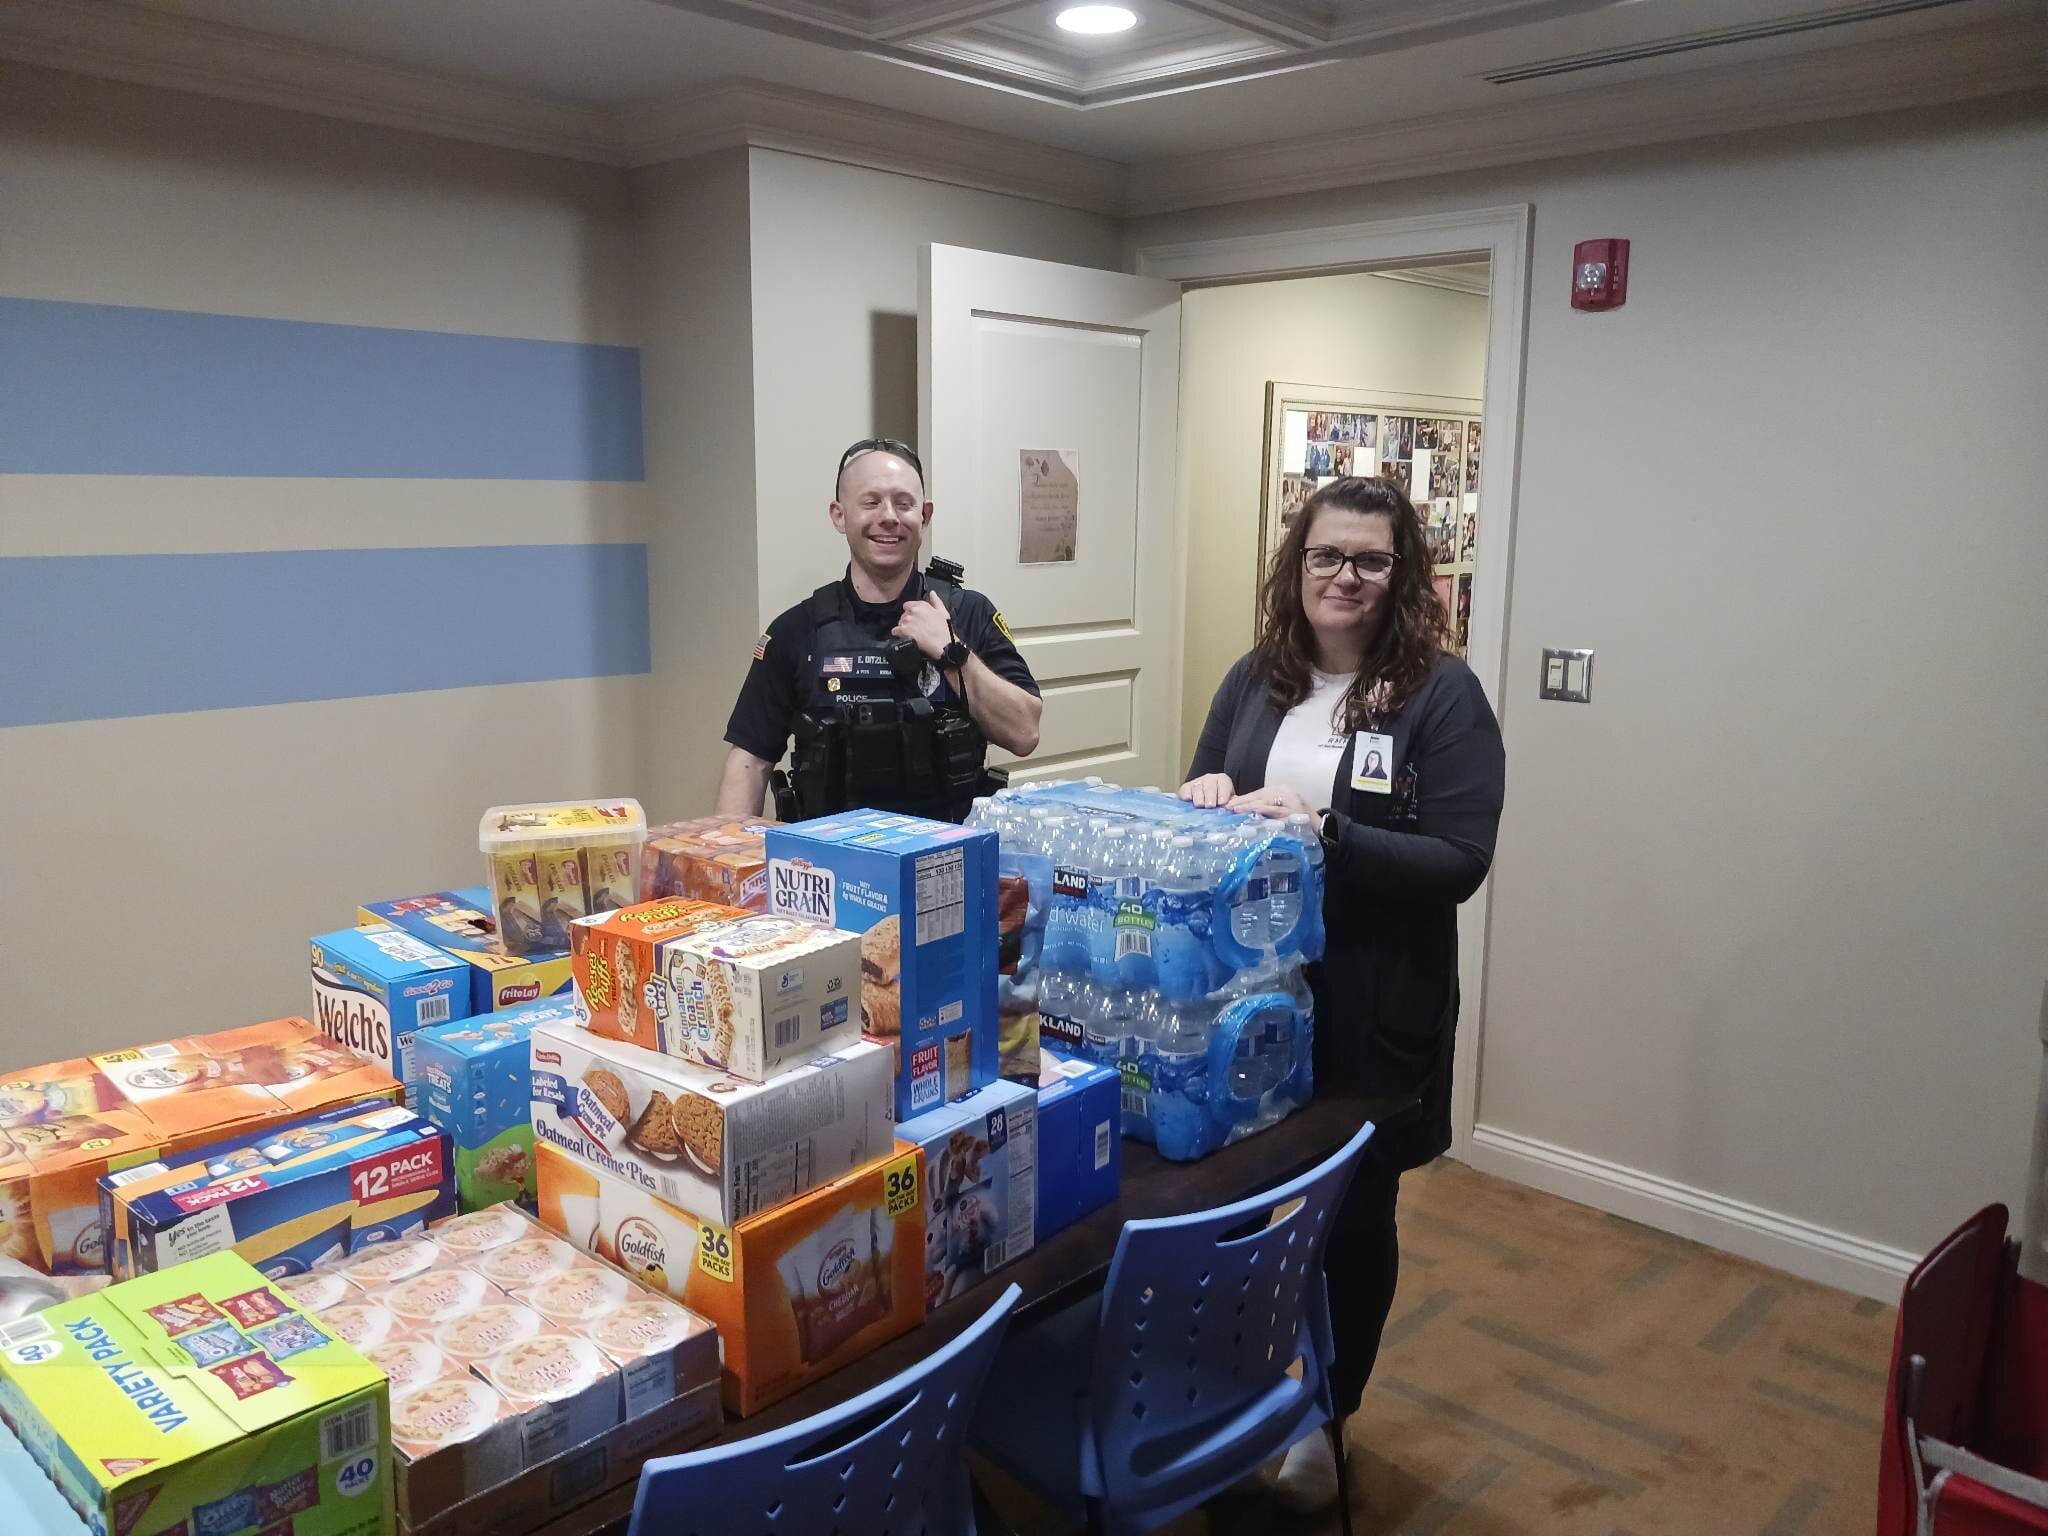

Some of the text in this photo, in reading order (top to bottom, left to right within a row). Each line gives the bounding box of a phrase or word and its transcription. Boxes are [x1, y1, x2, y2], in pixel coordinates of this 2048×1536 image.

[836, 694, 869, 703] POLICE
[775, 866, 830, 894] NUTRI
[842, 881, 861, 895] FRUIT
[860, 888, 883, 902] FLAVOR
[1054, 871, 1086, 889] LAND
[775, 889, 831, 918] GRAIN
[848, 893, 866, 906] WHOLE
[866, 898, 887, 913] GRAINS
[1120, 902, 1143, 915] 40
[1064, 908, 1104, 933] water
[584, 950, 600, 1012] Reese's
[597, 956, 611, 1008] Puffs
[644, 980, 658, 1009] 30
[652, 974, 669, 1019] Bars!
[675, 977, 690, 1040] Cinnamon
[684, 989, 697, 1032] Toast
[314, 989, 389, 1060] Welch's
[691, 981, 710, 1041] Crunch
[1040, 1014, 1082, 1037] KLAND
[912, 1045, 939, 1067] FRUIT
[912, 1059, 938, 1077] FLAVOR
[1116, 1060, 1138, 1074] 40
[427, 1072, 452, 1094] TREATS
[532, 1076, 558, 1090] Labeled
[532, 1086, 567, 1102] for Resale
[580, 1088, 616, 1132] Oatmeal
[990, 1113, 1004, 1135] 28
[536, 1119, 657, 1191] Oatmeal Creme Pies
[354, 1166, 390, 1199] 12
[390, 1151, 433, 1177] PACK
[887, 1166, 915, 1198] 36
[888, 1197, 916, 1215] PACKS
[621, 1232, 666, 1265] Goldfish
[701, 1225, 730, 1258] 36
[702, 1258, 731, 1277] PACKS
[822, 1246, 856, 1287] Goldfish
[64, 1316, 188, 1434] PACK VARIETY
[338, 1457, 374, 1483] 40
